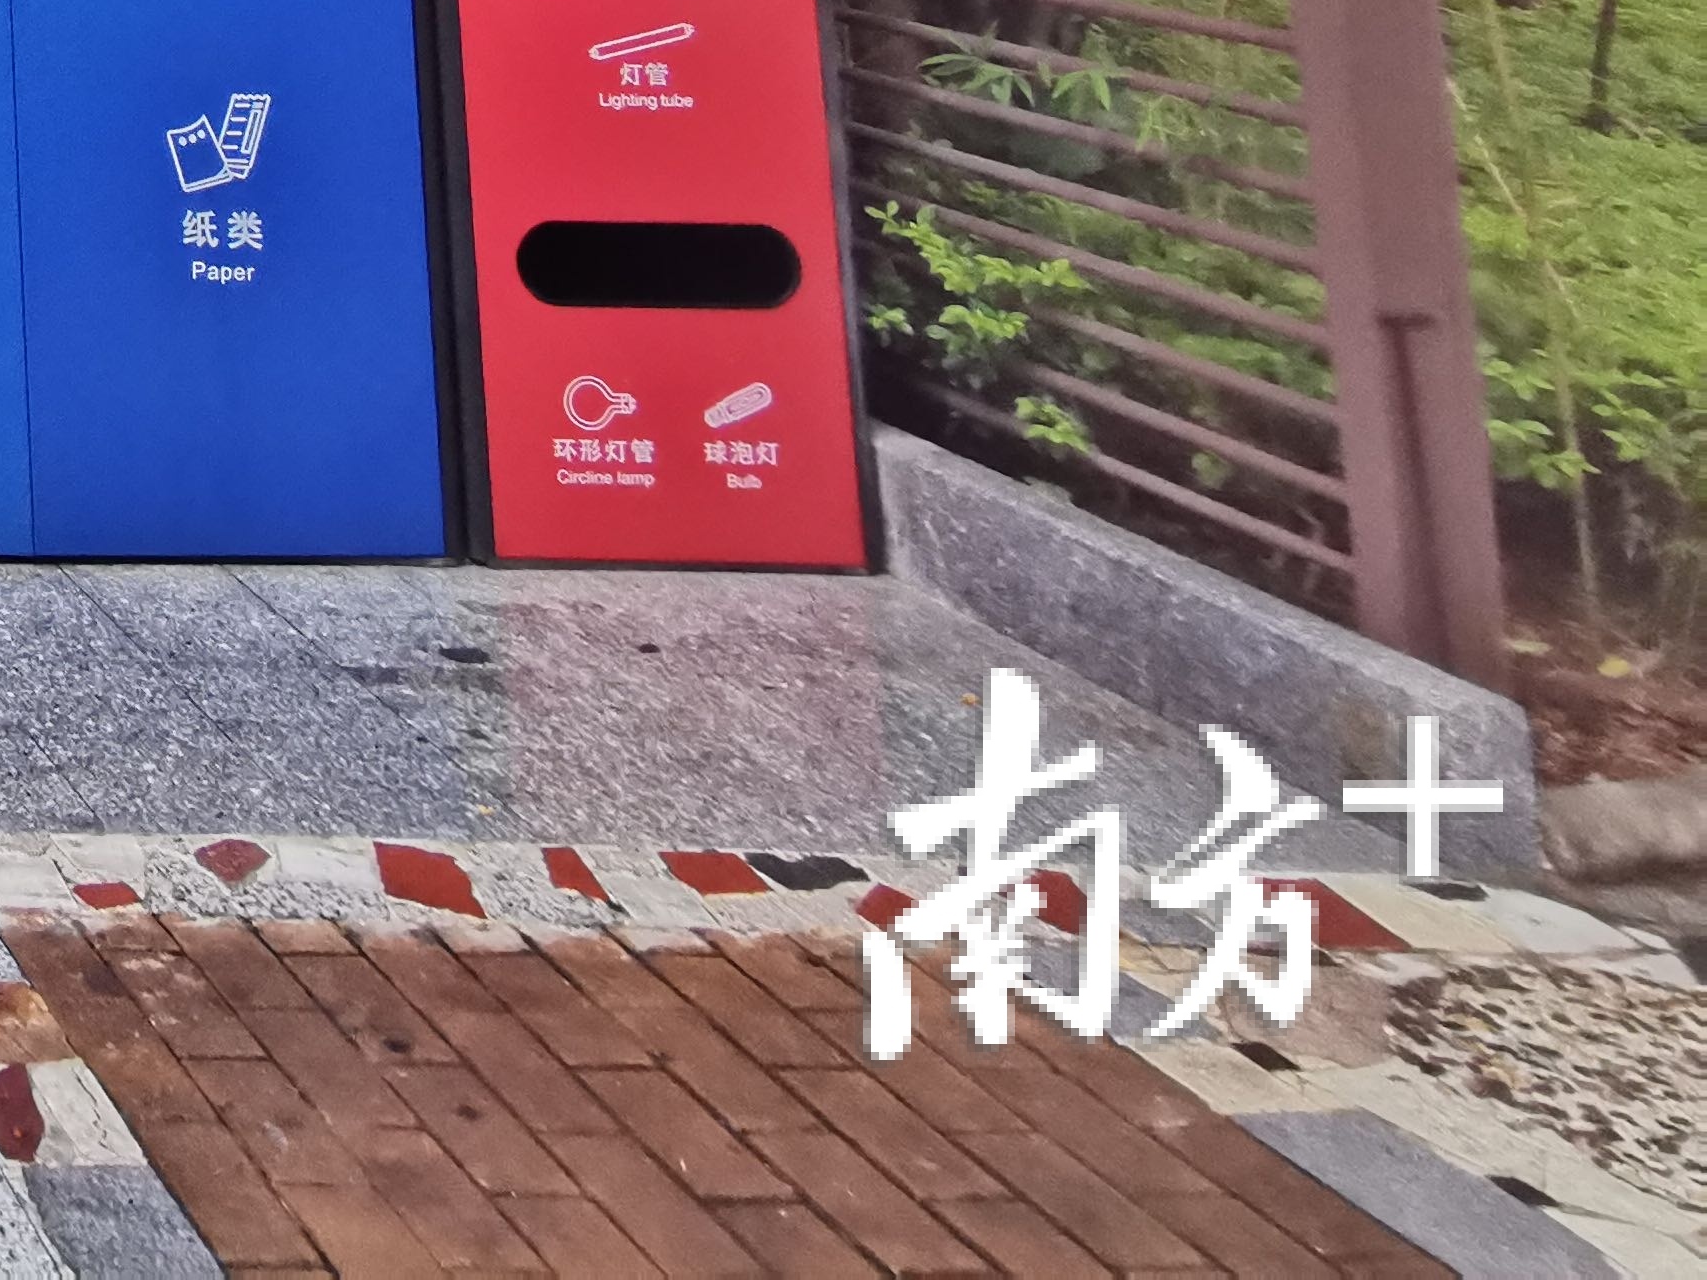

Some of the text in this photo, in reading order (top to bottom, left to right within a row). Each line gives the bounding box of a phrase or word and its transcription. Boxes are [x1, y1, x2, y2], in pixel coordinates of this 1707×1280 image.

[620, 62, 669, 86] 灯管
[599, 92, 694, 110] Lighting tube
[182, 209, 264, 250] 纸类
[192, 260, 256, 285] Paper
[553, 438, 655, 464] 环形灯管
[704, 441, 780, 466] 球泡灯
[616, 470, 656, 487] lamp
[726, 473, 763, 489] Bulb
